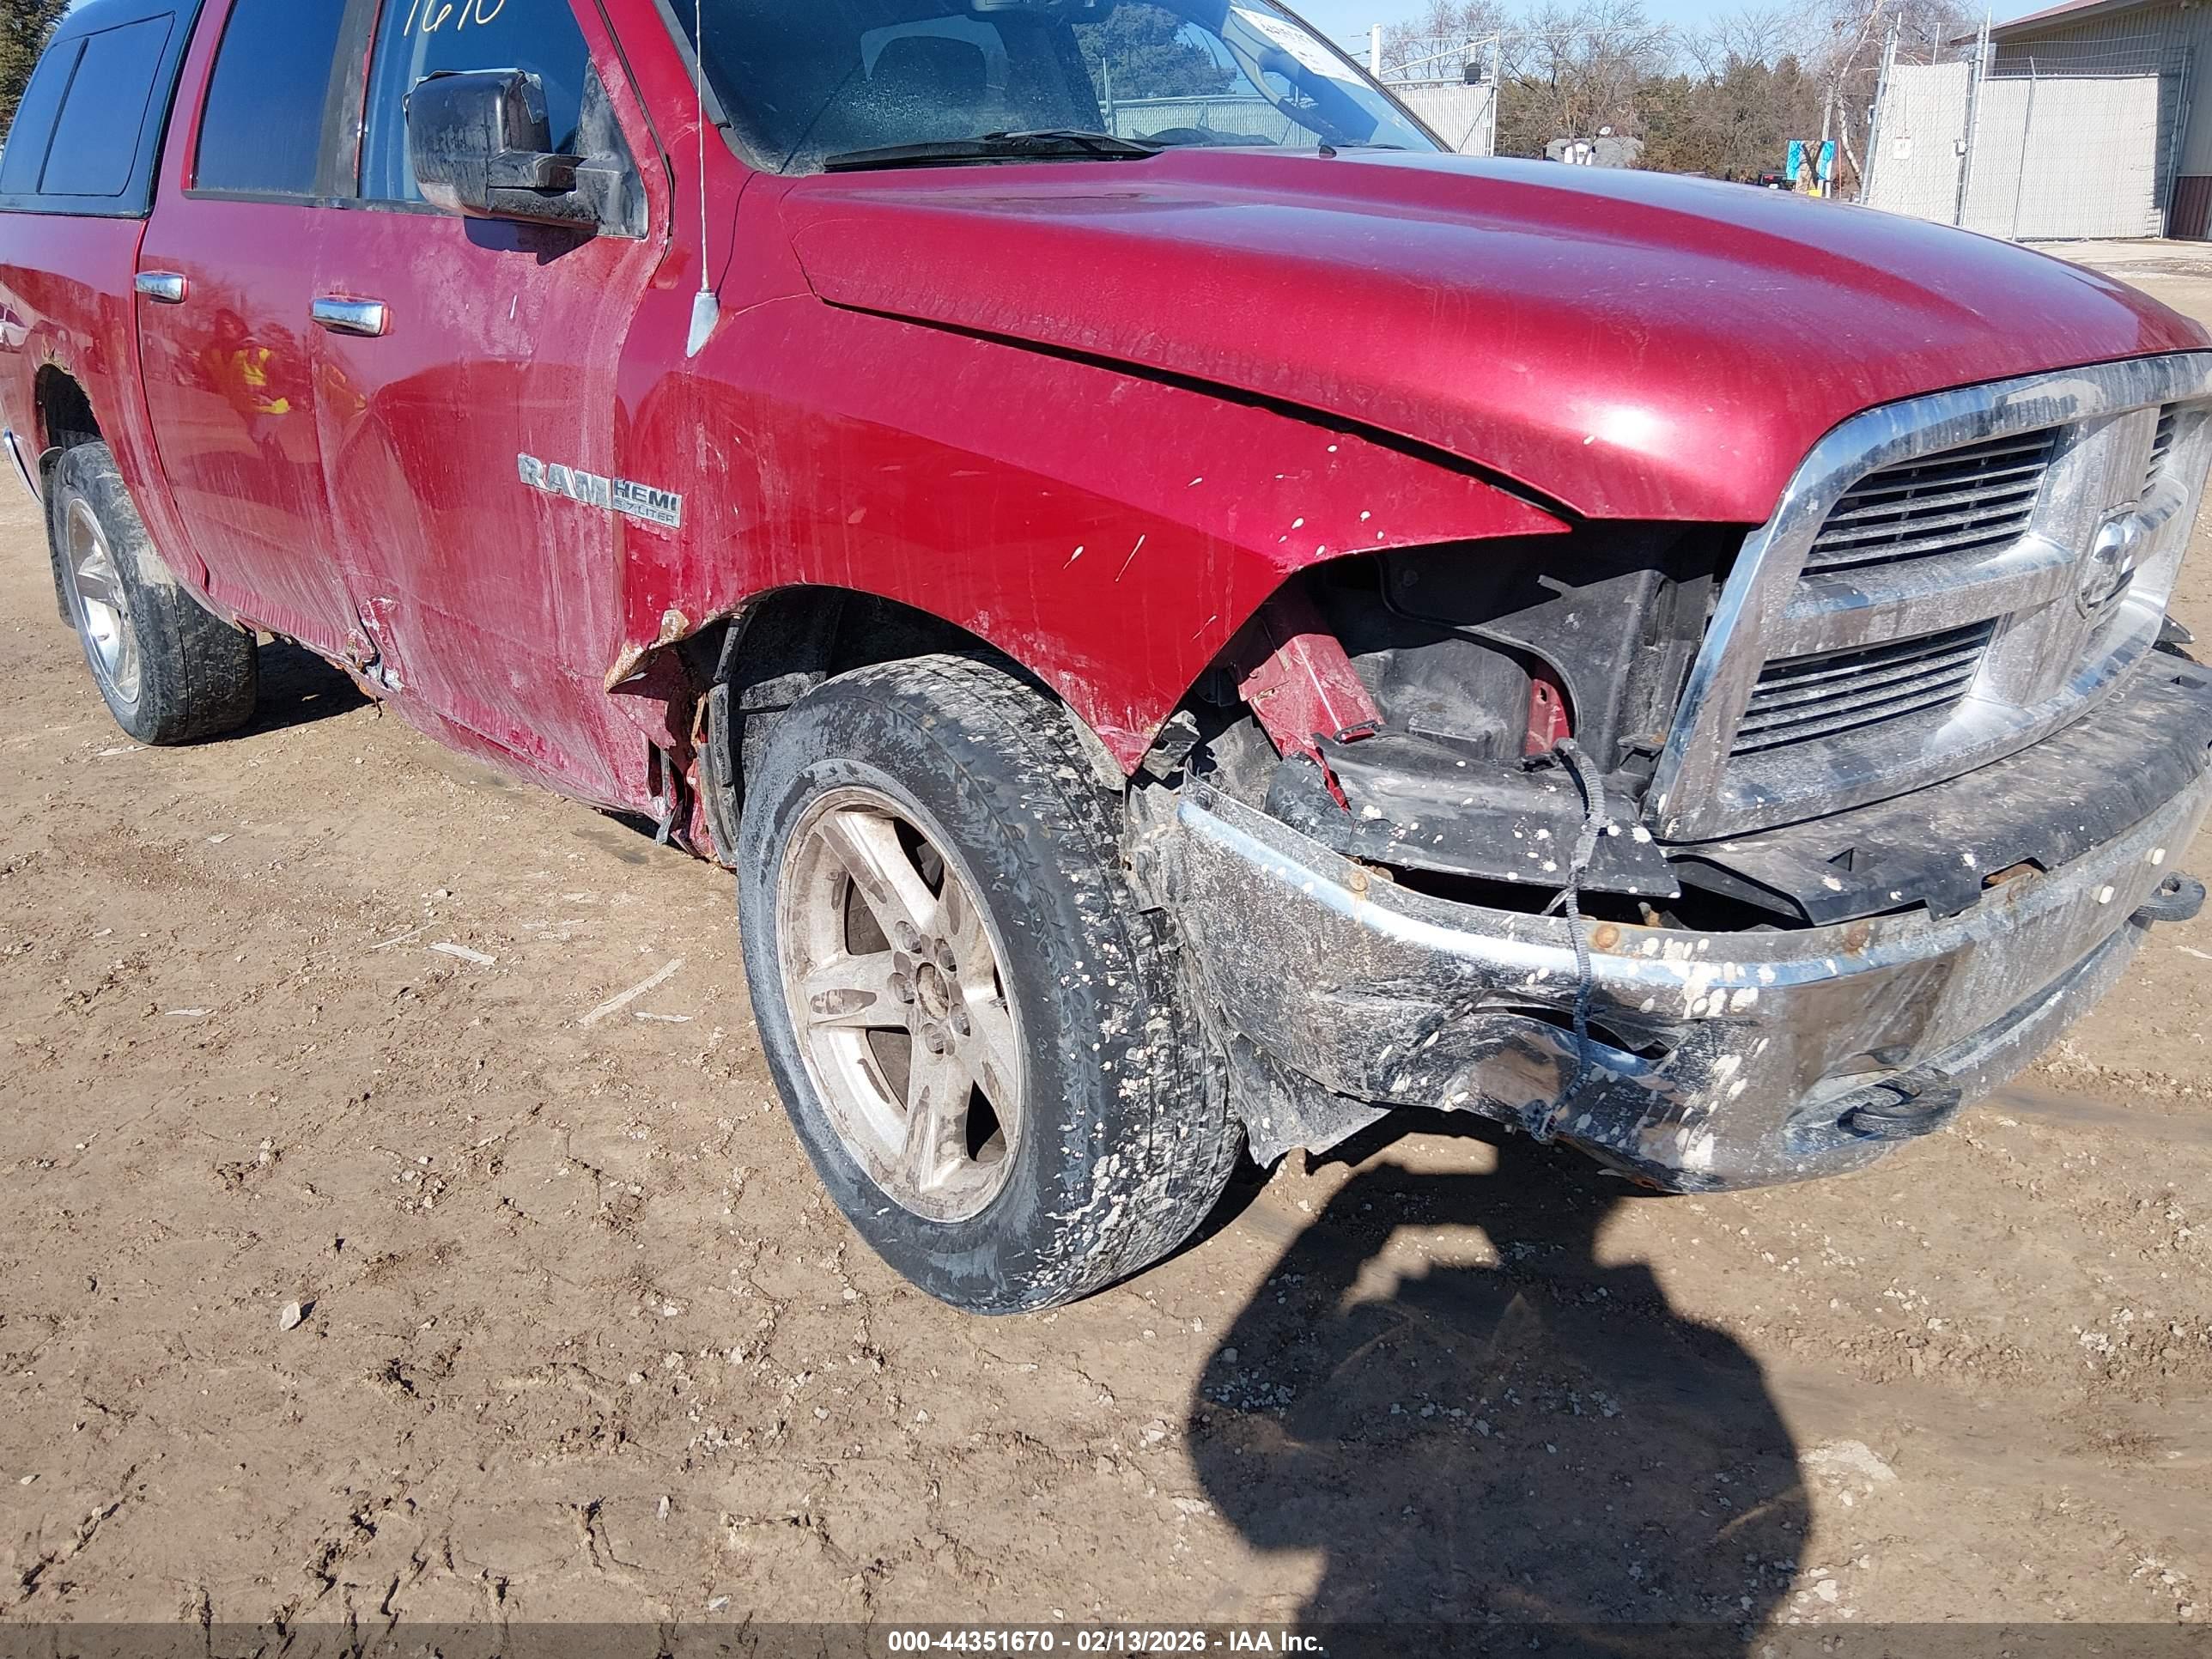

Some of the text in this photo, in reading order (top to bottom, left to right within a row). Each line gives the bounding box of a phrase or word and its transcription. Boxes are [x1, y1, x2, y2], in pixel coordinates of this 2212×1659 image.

[518, 453, 613, 510] RAM
[614, 479, 678, 511] HEMI
[638, 506, 674, 524] LITER
